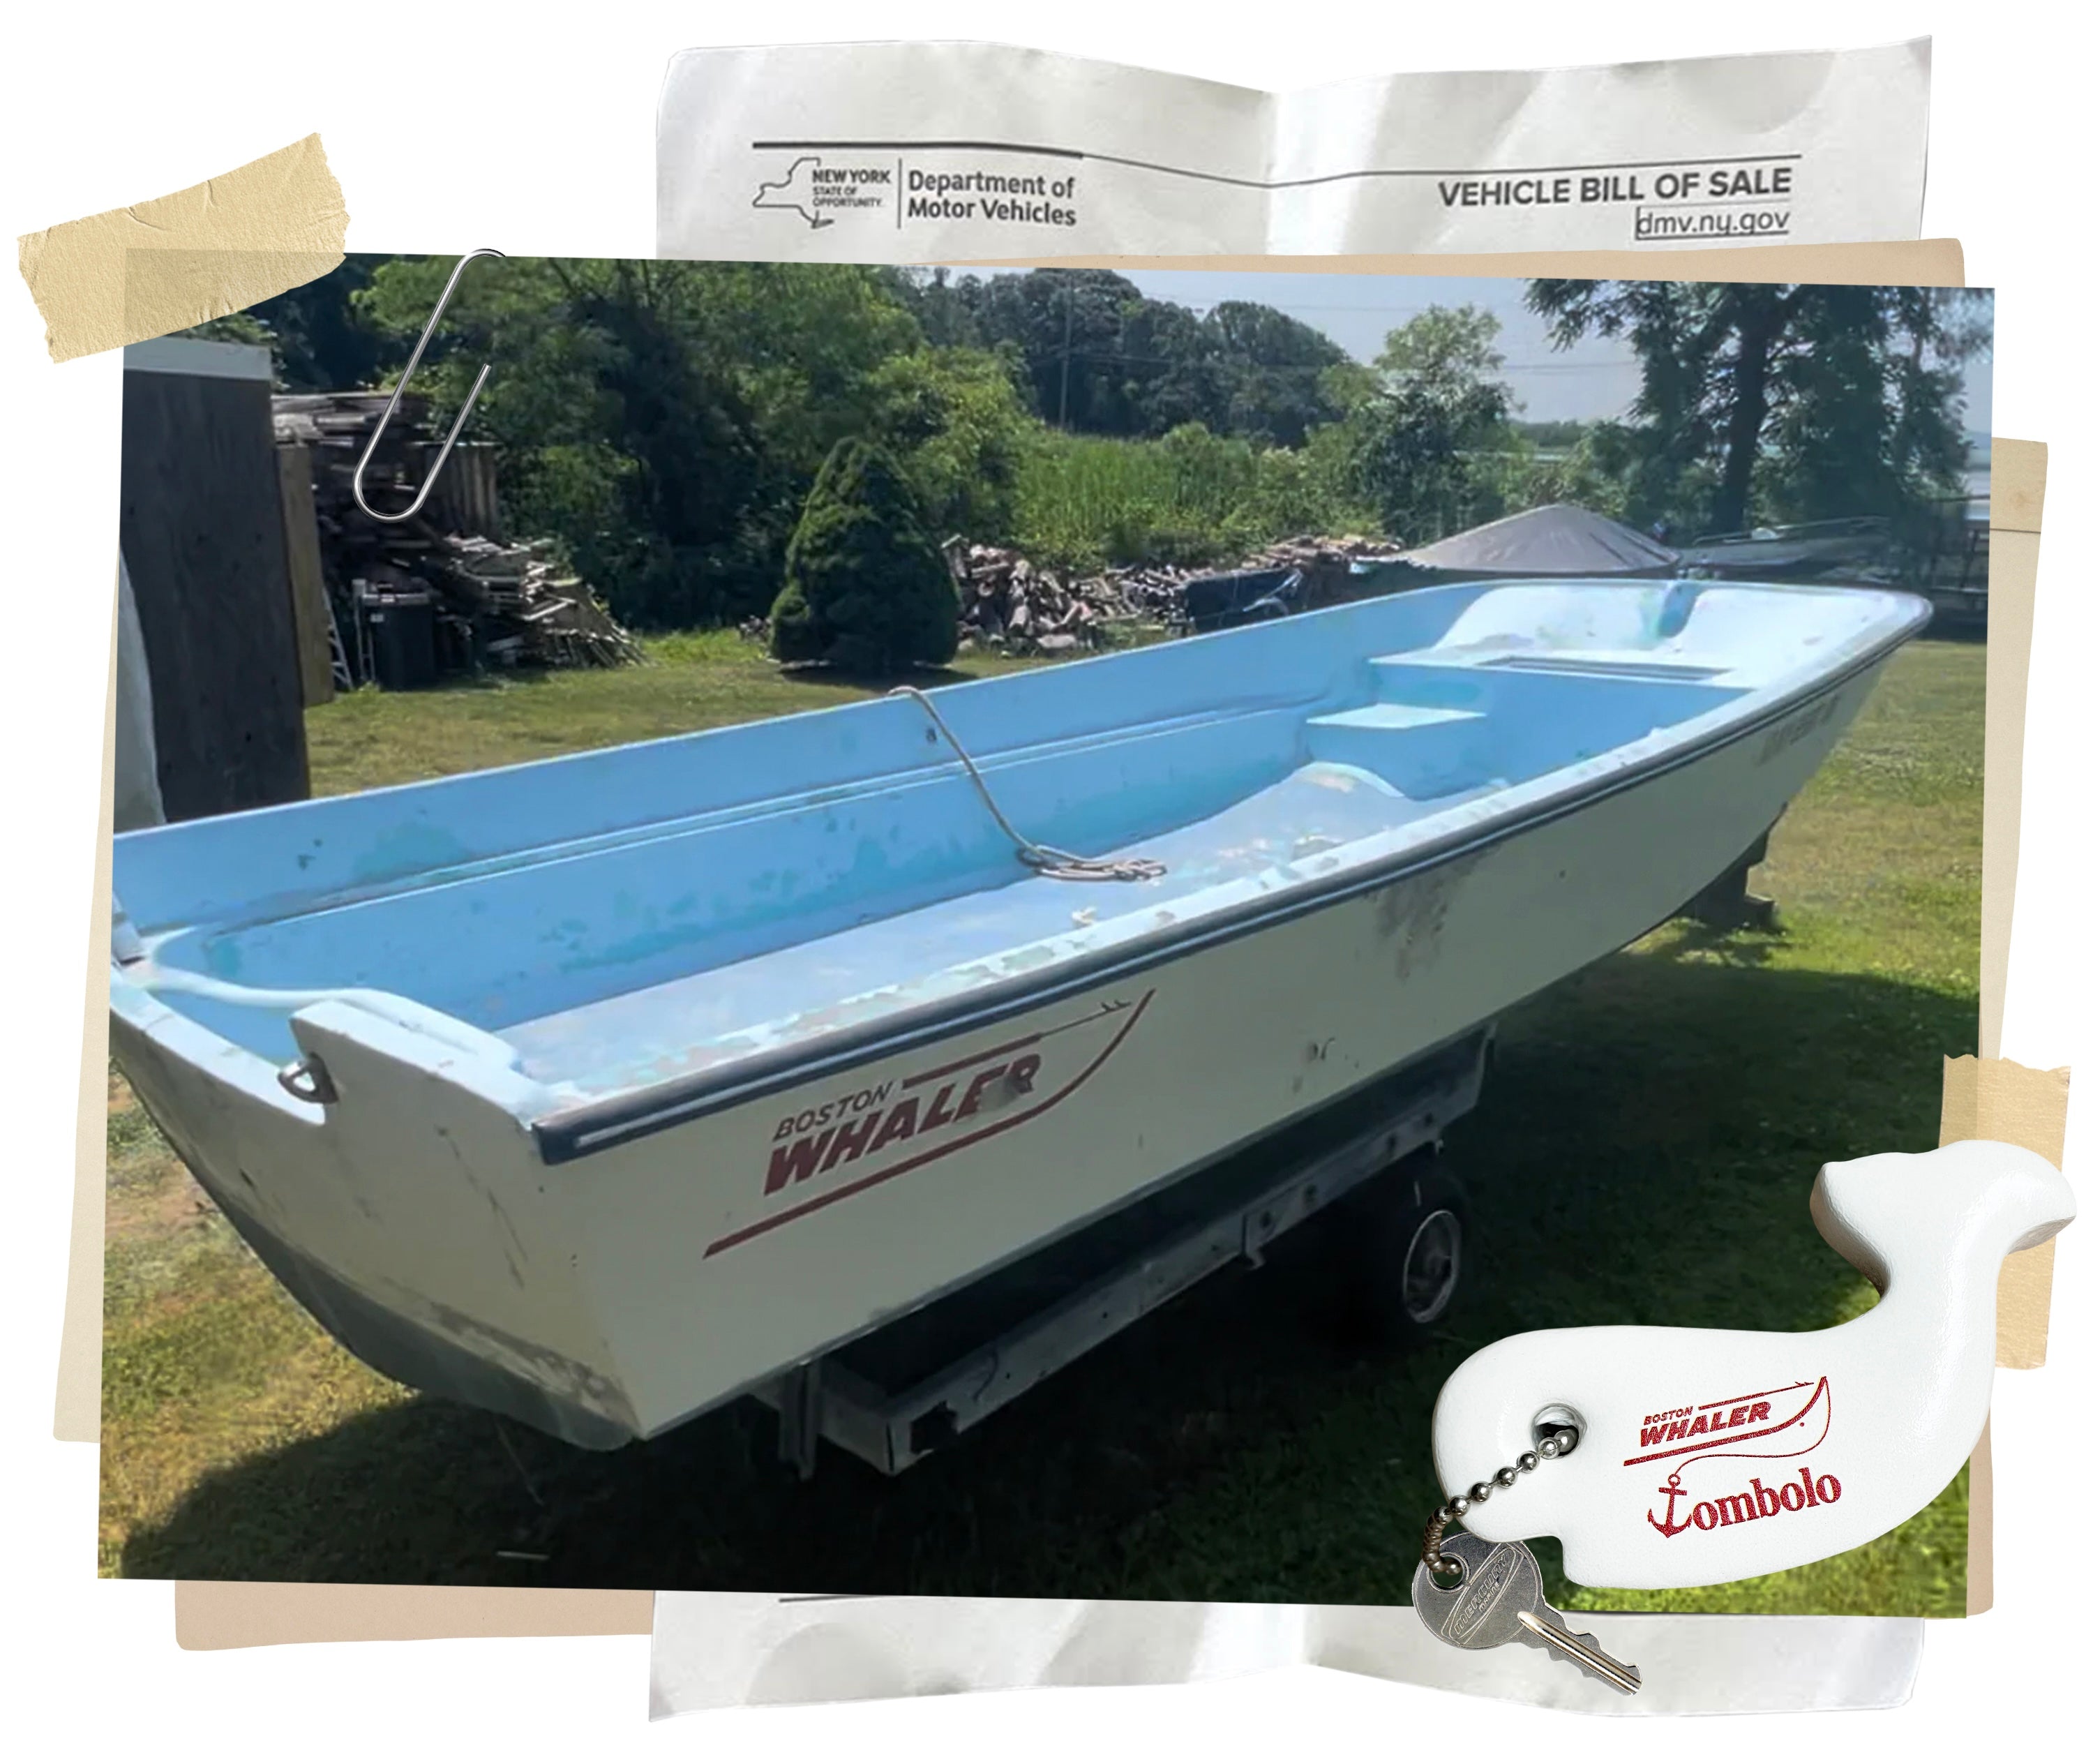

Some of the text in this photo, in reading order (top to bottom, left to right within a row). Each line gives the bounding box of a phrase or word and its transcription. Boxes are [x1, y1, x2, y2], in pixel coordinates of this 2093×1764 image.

[813, 169, 891, 183] NEW YORK
[813, 186, 857, 195] STATE OF
[908, 170, 1075, 199] Department of
[1438, 167, 1792, 207] VEHICLE BILL OF SALE
[907, 198, 1076, 227] Motor Vehicles
[1637, 209, 1790, 236] dmv.ny.gov
[764, 1053, 1042, 1196] WHALER
[772, 1081, 895, 1142] BOSTON
[1640, 1400, 1772, 1448] WHALER
[1643, 1405, 1694, 1426] BOSTON
[1454, 1553, 1508, 1635] MERCURY
[1478, 1581, 1500, 1612] MARINE
